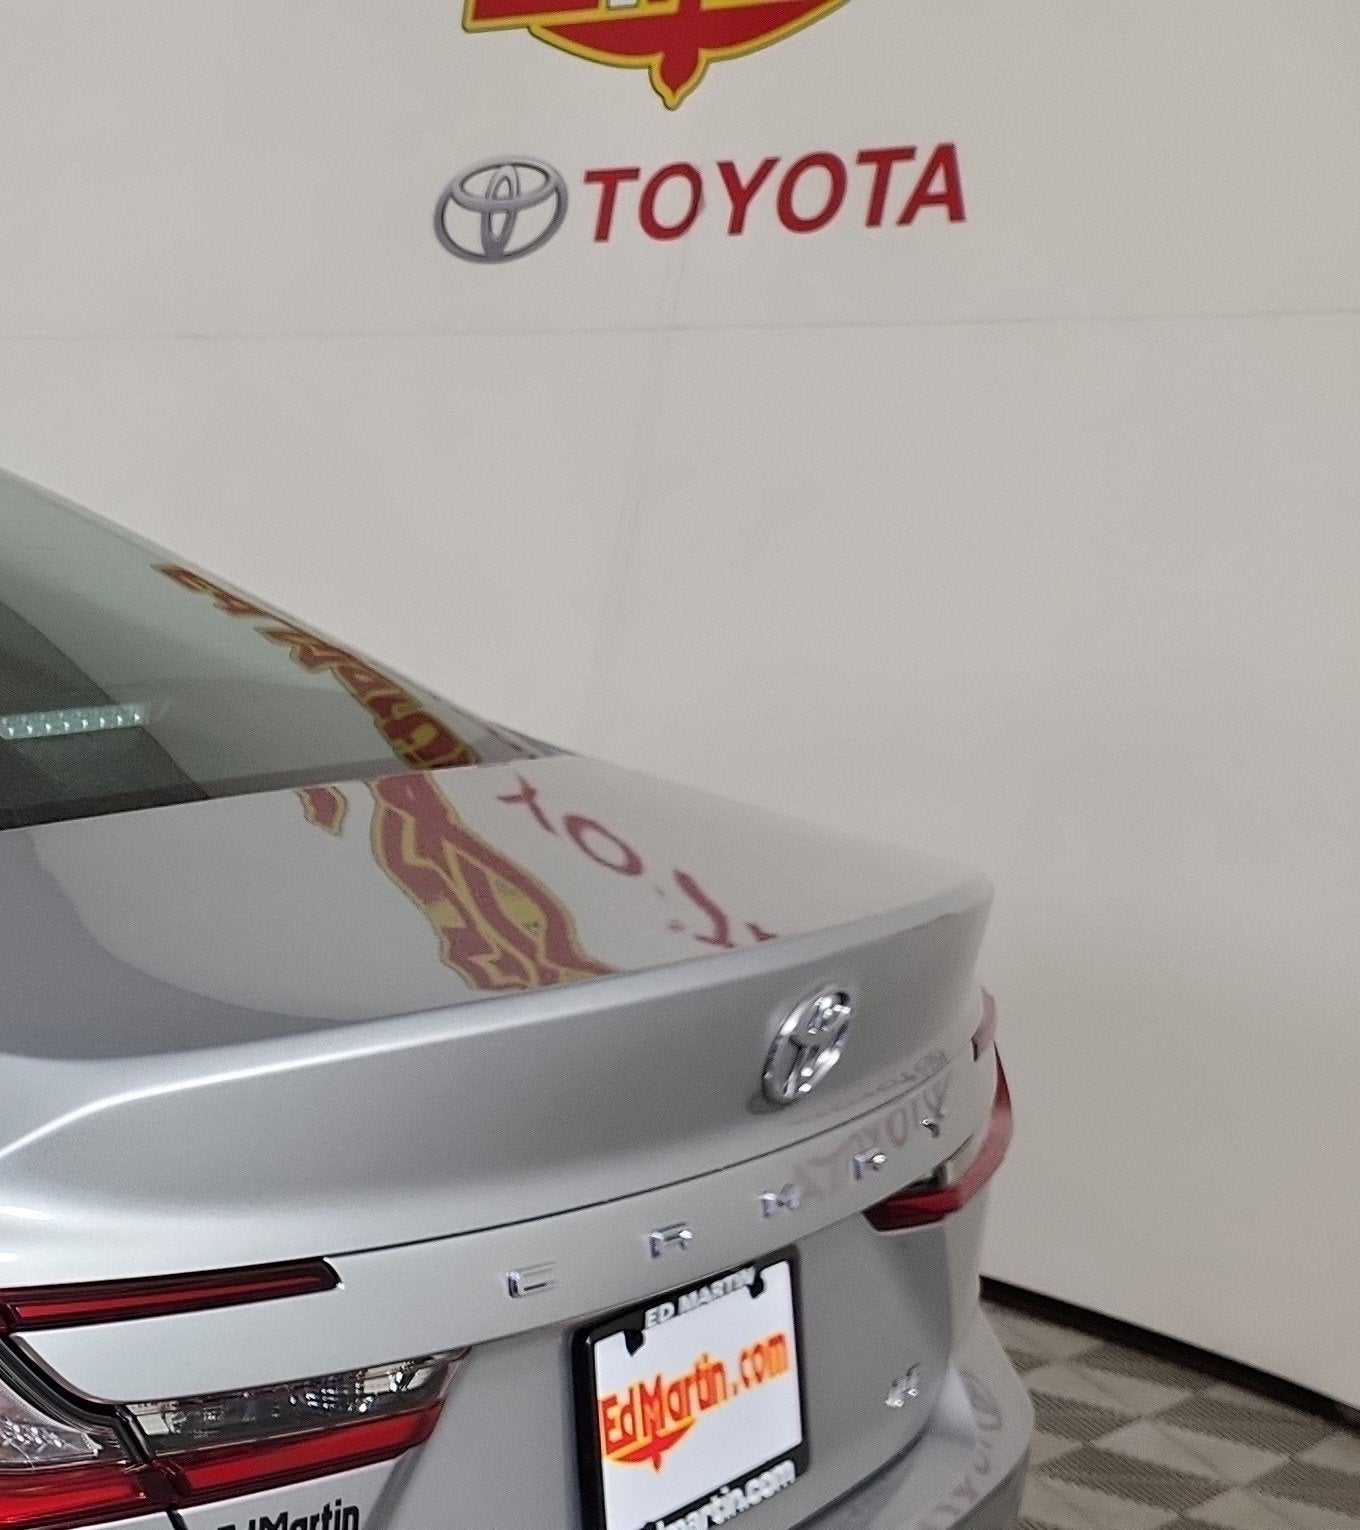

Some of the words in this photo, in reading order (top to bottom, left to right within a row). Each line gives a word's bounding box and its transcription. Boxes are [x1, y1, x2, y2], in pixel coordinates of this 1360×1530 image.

[583, 142, 967, 243] TOYOTA
[645, 1301, 676, 1329] ED
[679, 1266, 756, 1317] MARTIN
